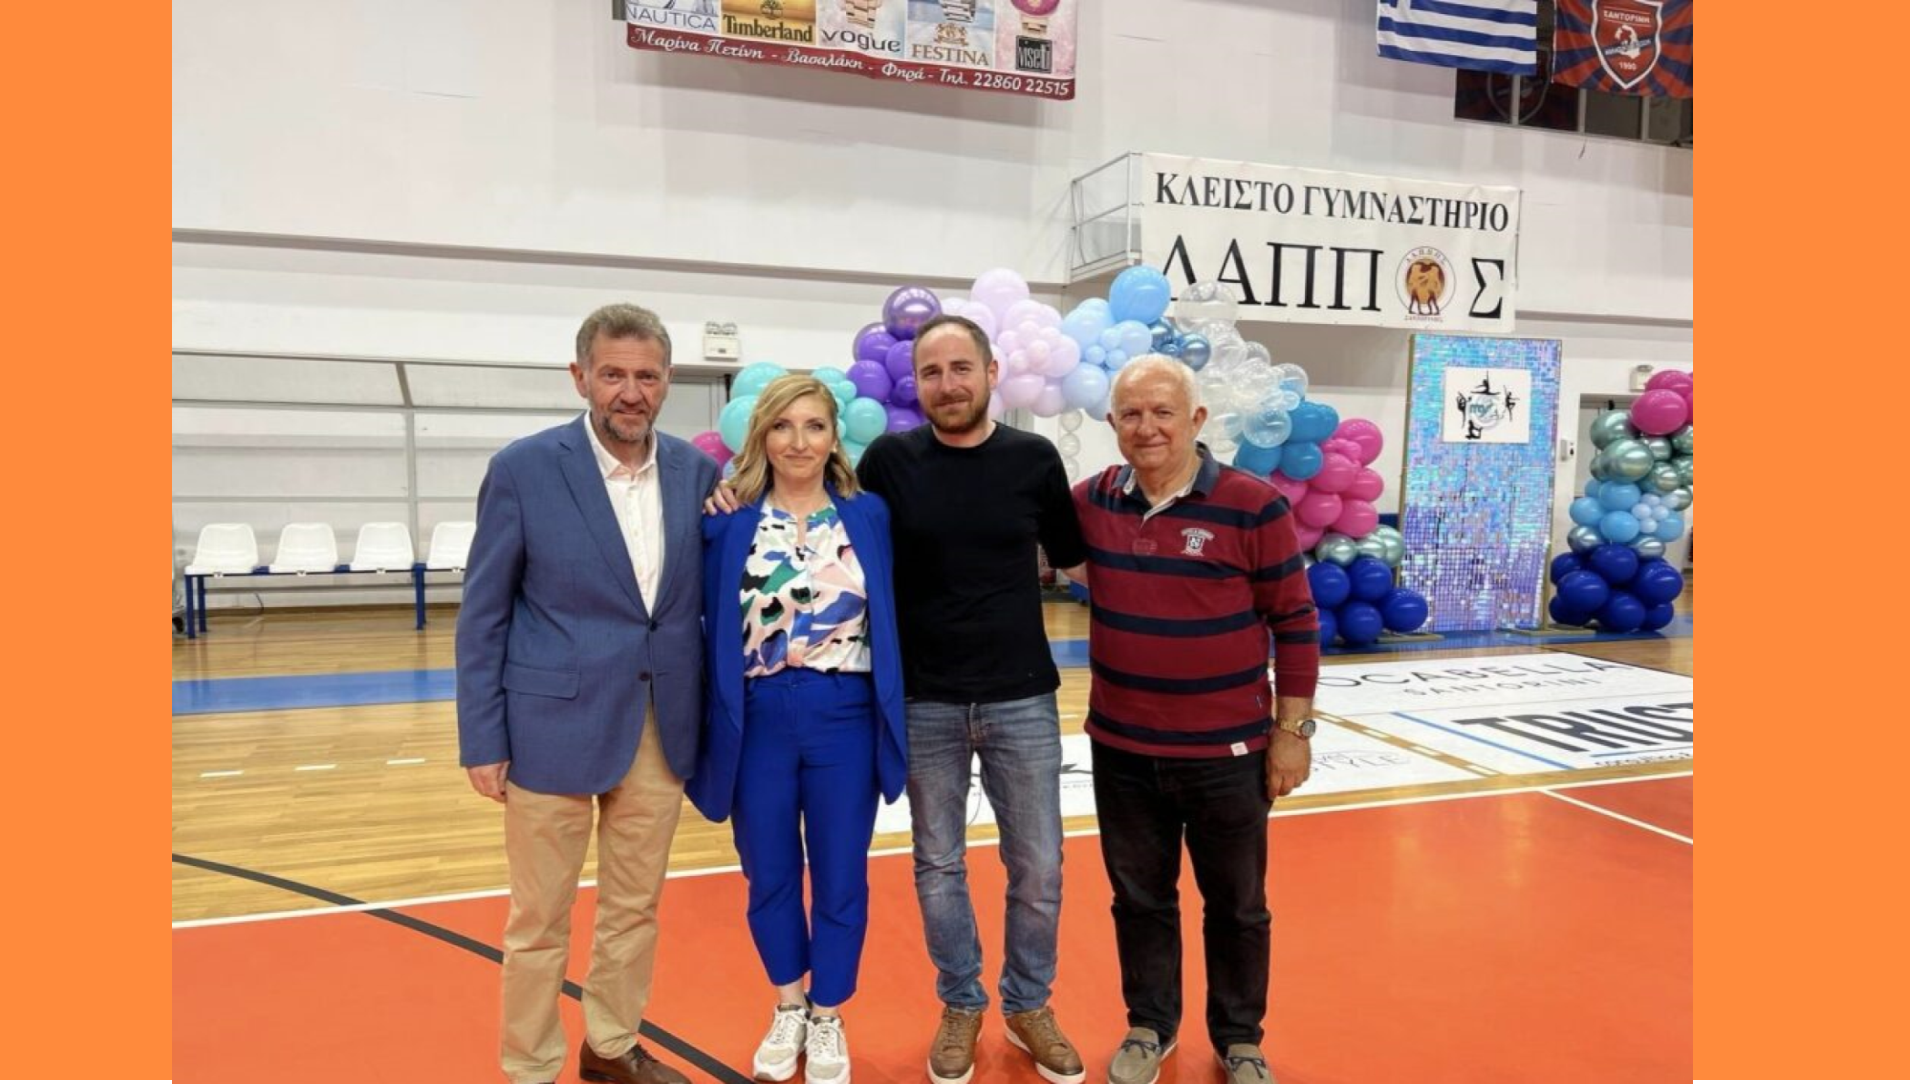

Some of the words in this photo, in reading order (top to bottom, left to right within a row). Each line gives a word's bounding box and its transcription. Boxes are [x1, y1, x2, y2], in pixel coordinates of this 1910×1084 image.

[627, 7, 716, 31] NAUTICA
[722, 13, 813, 43] Timberland
[821, 29, 901, 52] vogue
[630, 28, 701, 51] Μαρίνα
[881, 62, 926, 82] Φηρά
[974, 72, 1021, 91] 22860
[1026, 79, 1070, 96] 22515
[912, 44, 989, 66] FESTINA
[1155, 172, 1294, 214] ΚΛΕΙΣΤΟ
[1303, 185, 1509, 232] ΓΥΜΝΑΣΤΗΡΙΟ
[1317, 660, 1633, 687] OCABELLA
[1404, 677, 1603, 696] SANTORINI
